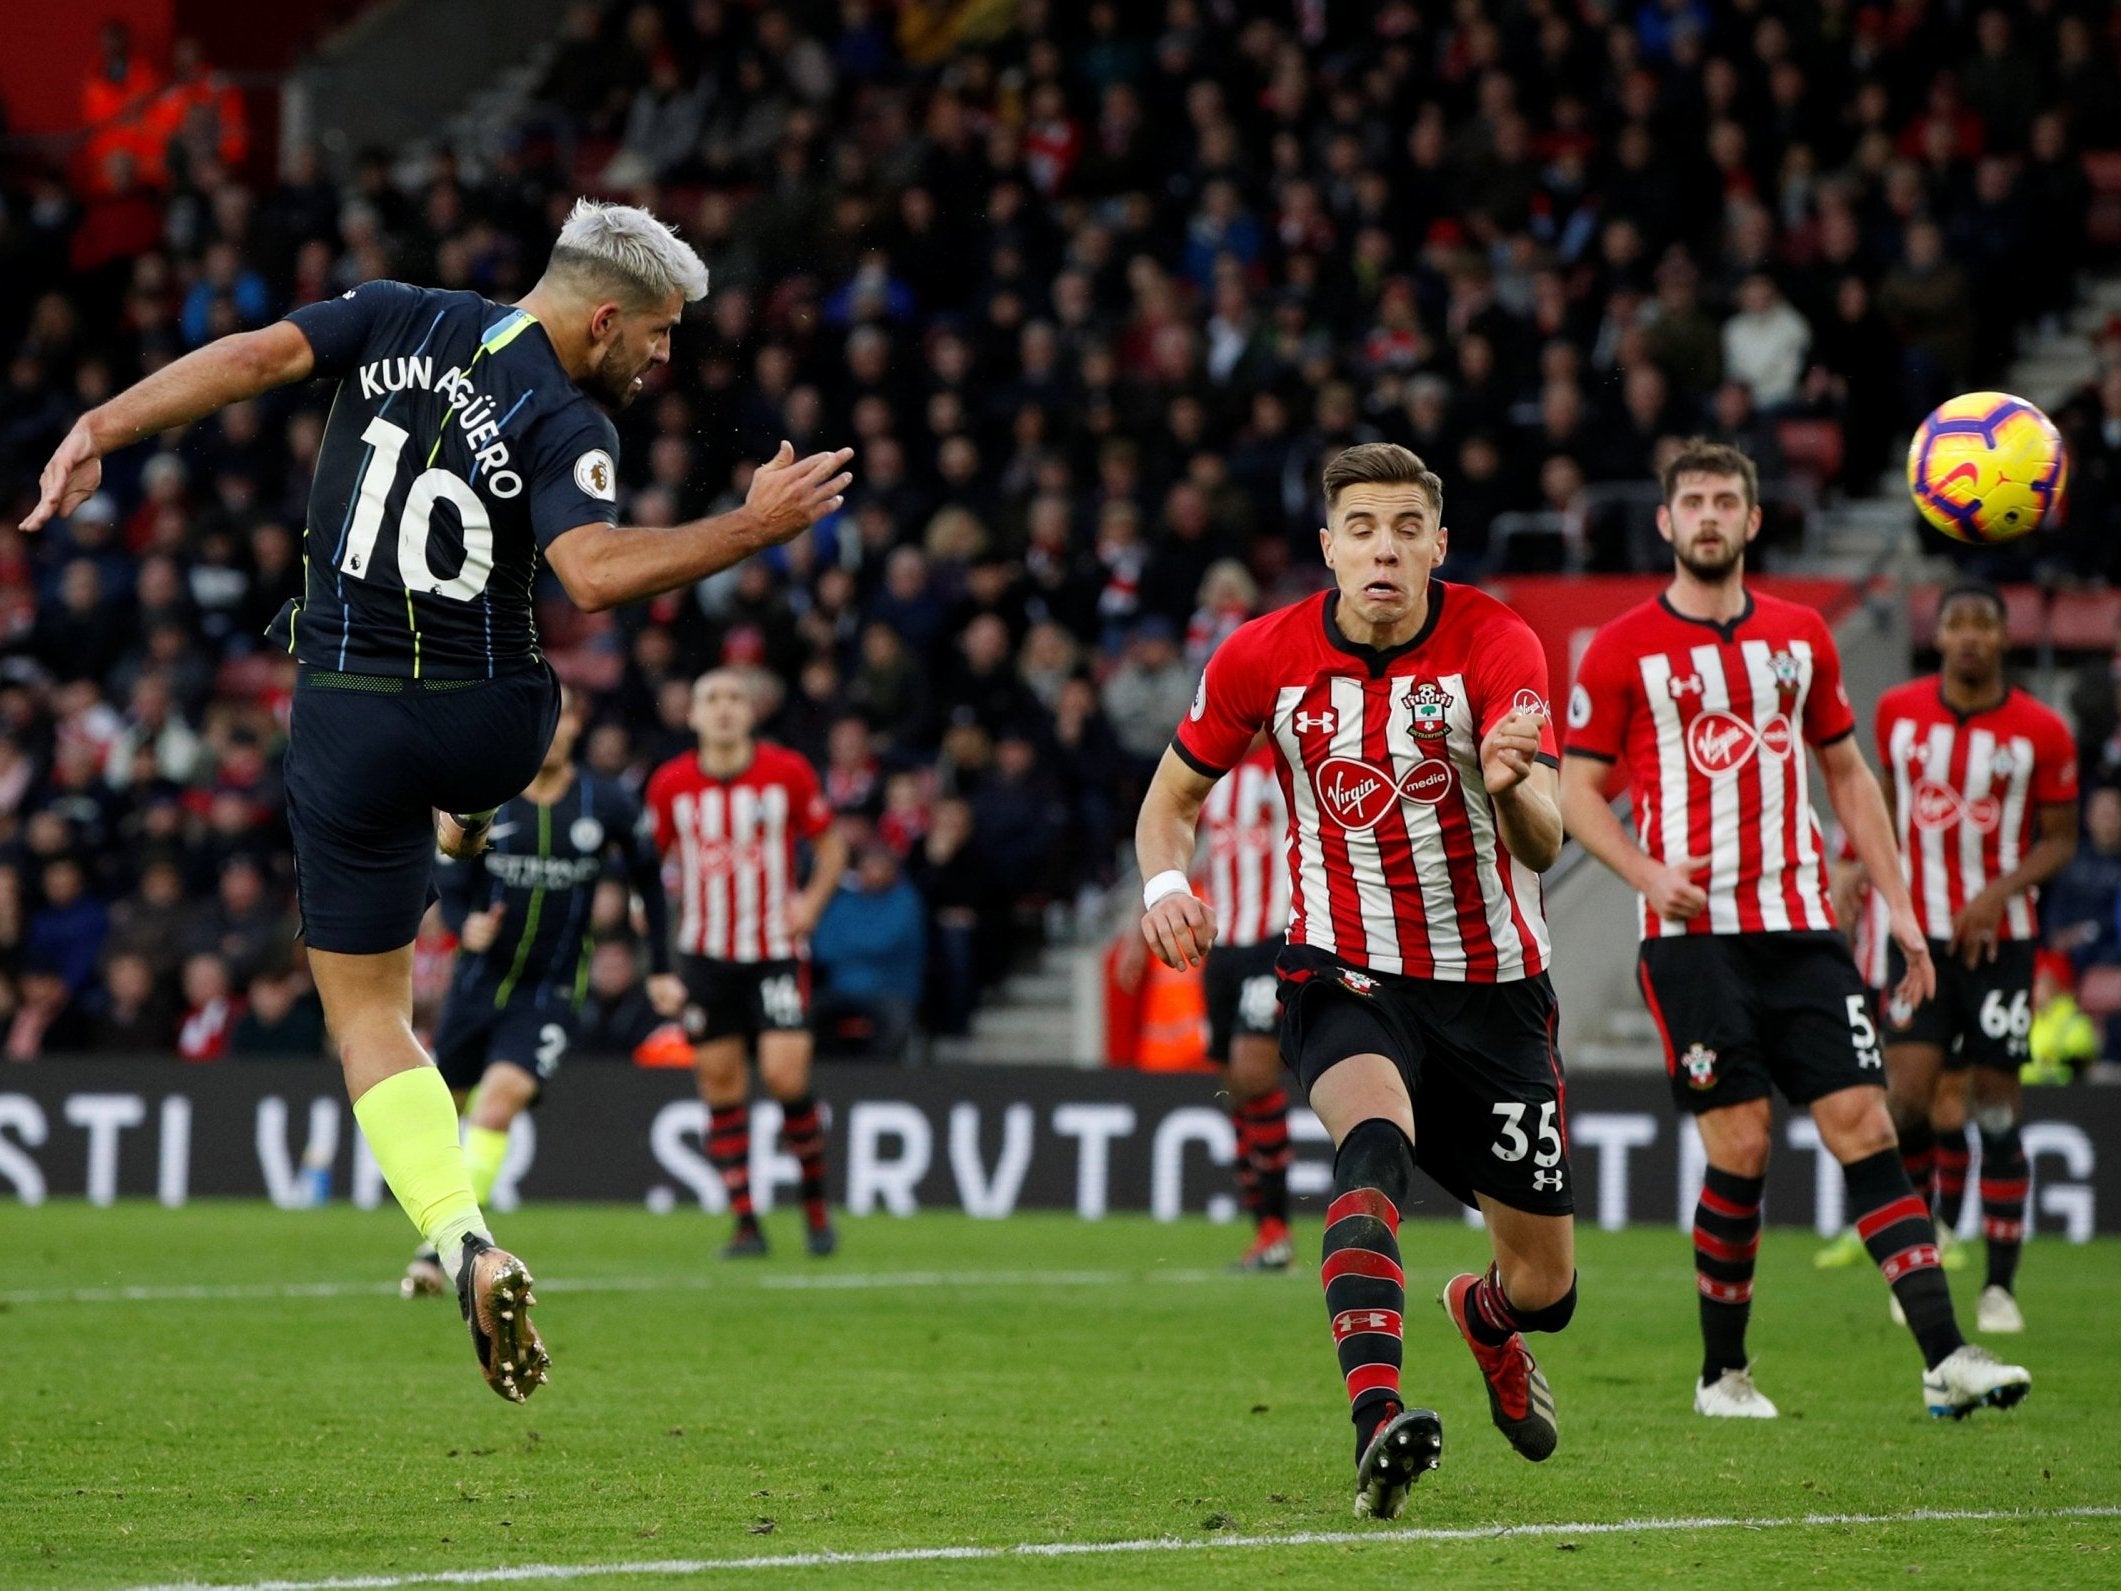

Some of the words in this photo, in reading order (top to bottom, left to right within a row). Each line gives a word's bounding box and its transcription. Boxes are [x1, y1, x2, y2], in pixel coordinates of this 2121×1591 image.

[359, 355, 432, 400] KUN
[433, 365, 523, 499] AGÜERO
[339, 415, 494, 602] 10
[1327, 770, 1381, 818] Virgin
[1406, 773, 1447, 792] media
[1845, 993, 1876, 1050] 5
[1980, 989, 2032, 1039] 66
[1491, 1100, 1562, 1168] 35
